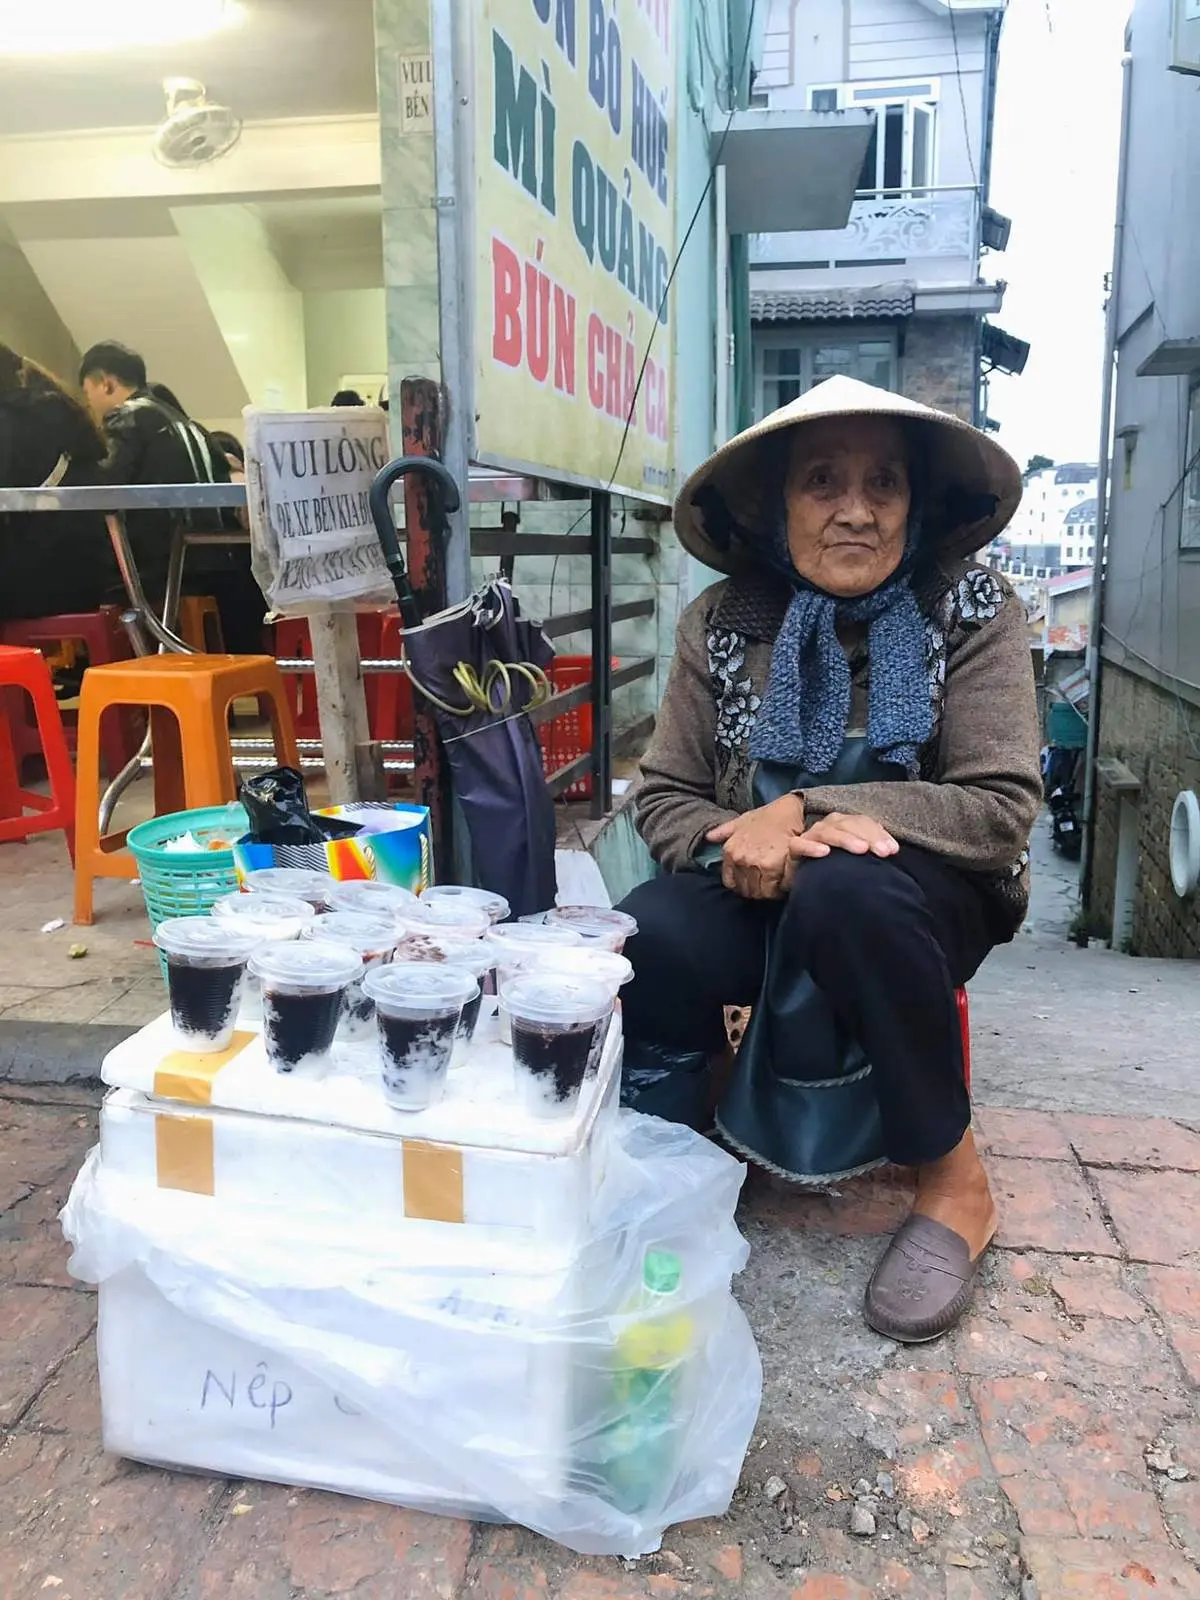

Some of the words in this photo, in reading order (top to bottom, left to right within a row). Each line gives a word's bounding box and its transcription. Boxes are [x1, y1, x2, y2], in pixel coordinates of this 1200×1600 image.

[402, 61, 424, 84] VUI
[493, 28, 556, 217] MÌ
[572, 140, 668, 325] QUẢNG
[632, 58, 668, 207] HUẾ
[492, 236, 575, 396] BÚN
[588, 310, 637, 426] CHẢ
[267, 440, 318, 478] VUI
[293, 499, 312, 536] XE
